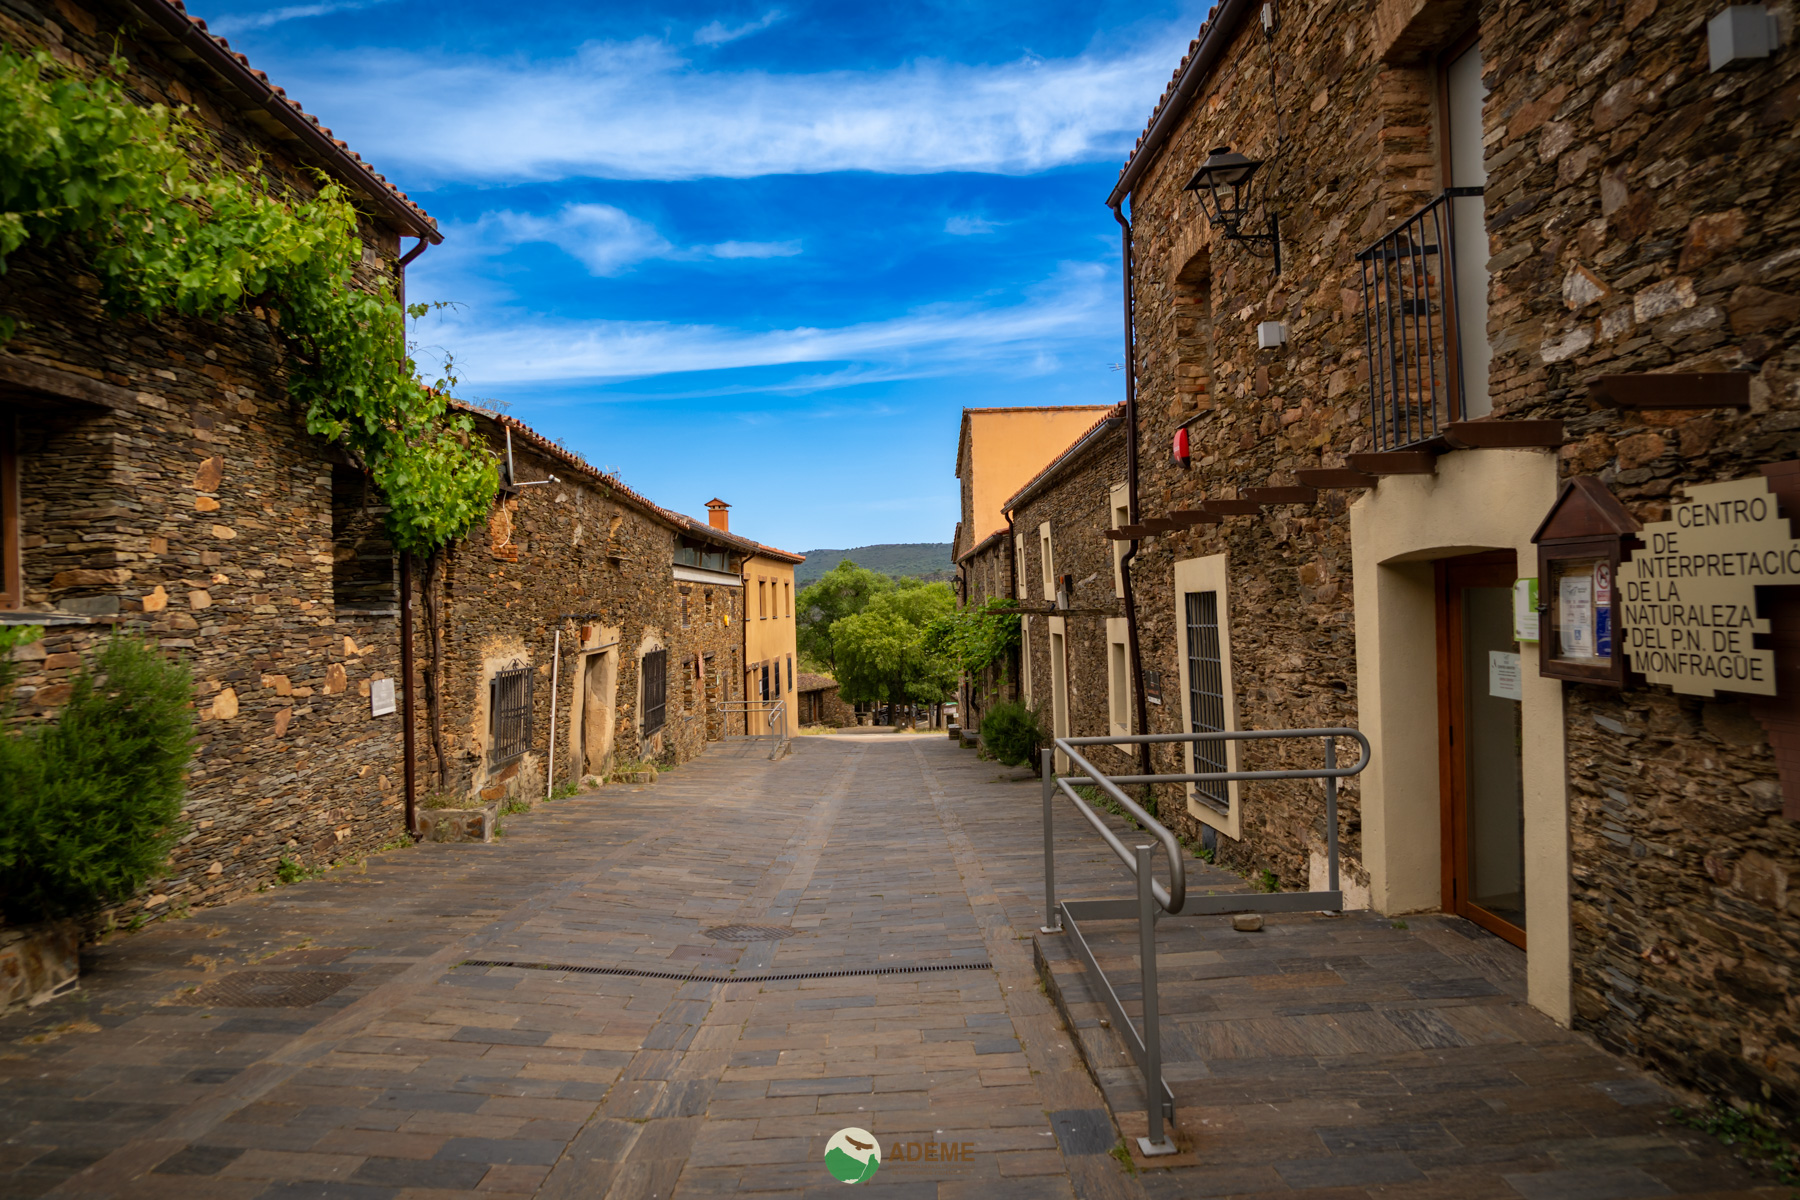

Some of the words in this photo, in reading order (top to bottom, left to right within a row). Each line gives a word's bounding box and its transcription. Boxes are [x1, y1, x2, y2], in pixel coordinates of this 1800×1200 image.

[1677, 497, 1768, 528] CENTRO
[1653, 532, 1679, 554] DE
[1627, 581, 1651, 602] DE
[1656, 581, 1680, 602] LA
[1625, 605, 1754, 628] NATURALEZA
[1632, 629, 1666, 649] DEL
[1672, 630, 1706, 652] P.N.
[1713, 631, 1741, 654] DE
[1636, 652, 1764, 681] MONFRAGÜE
